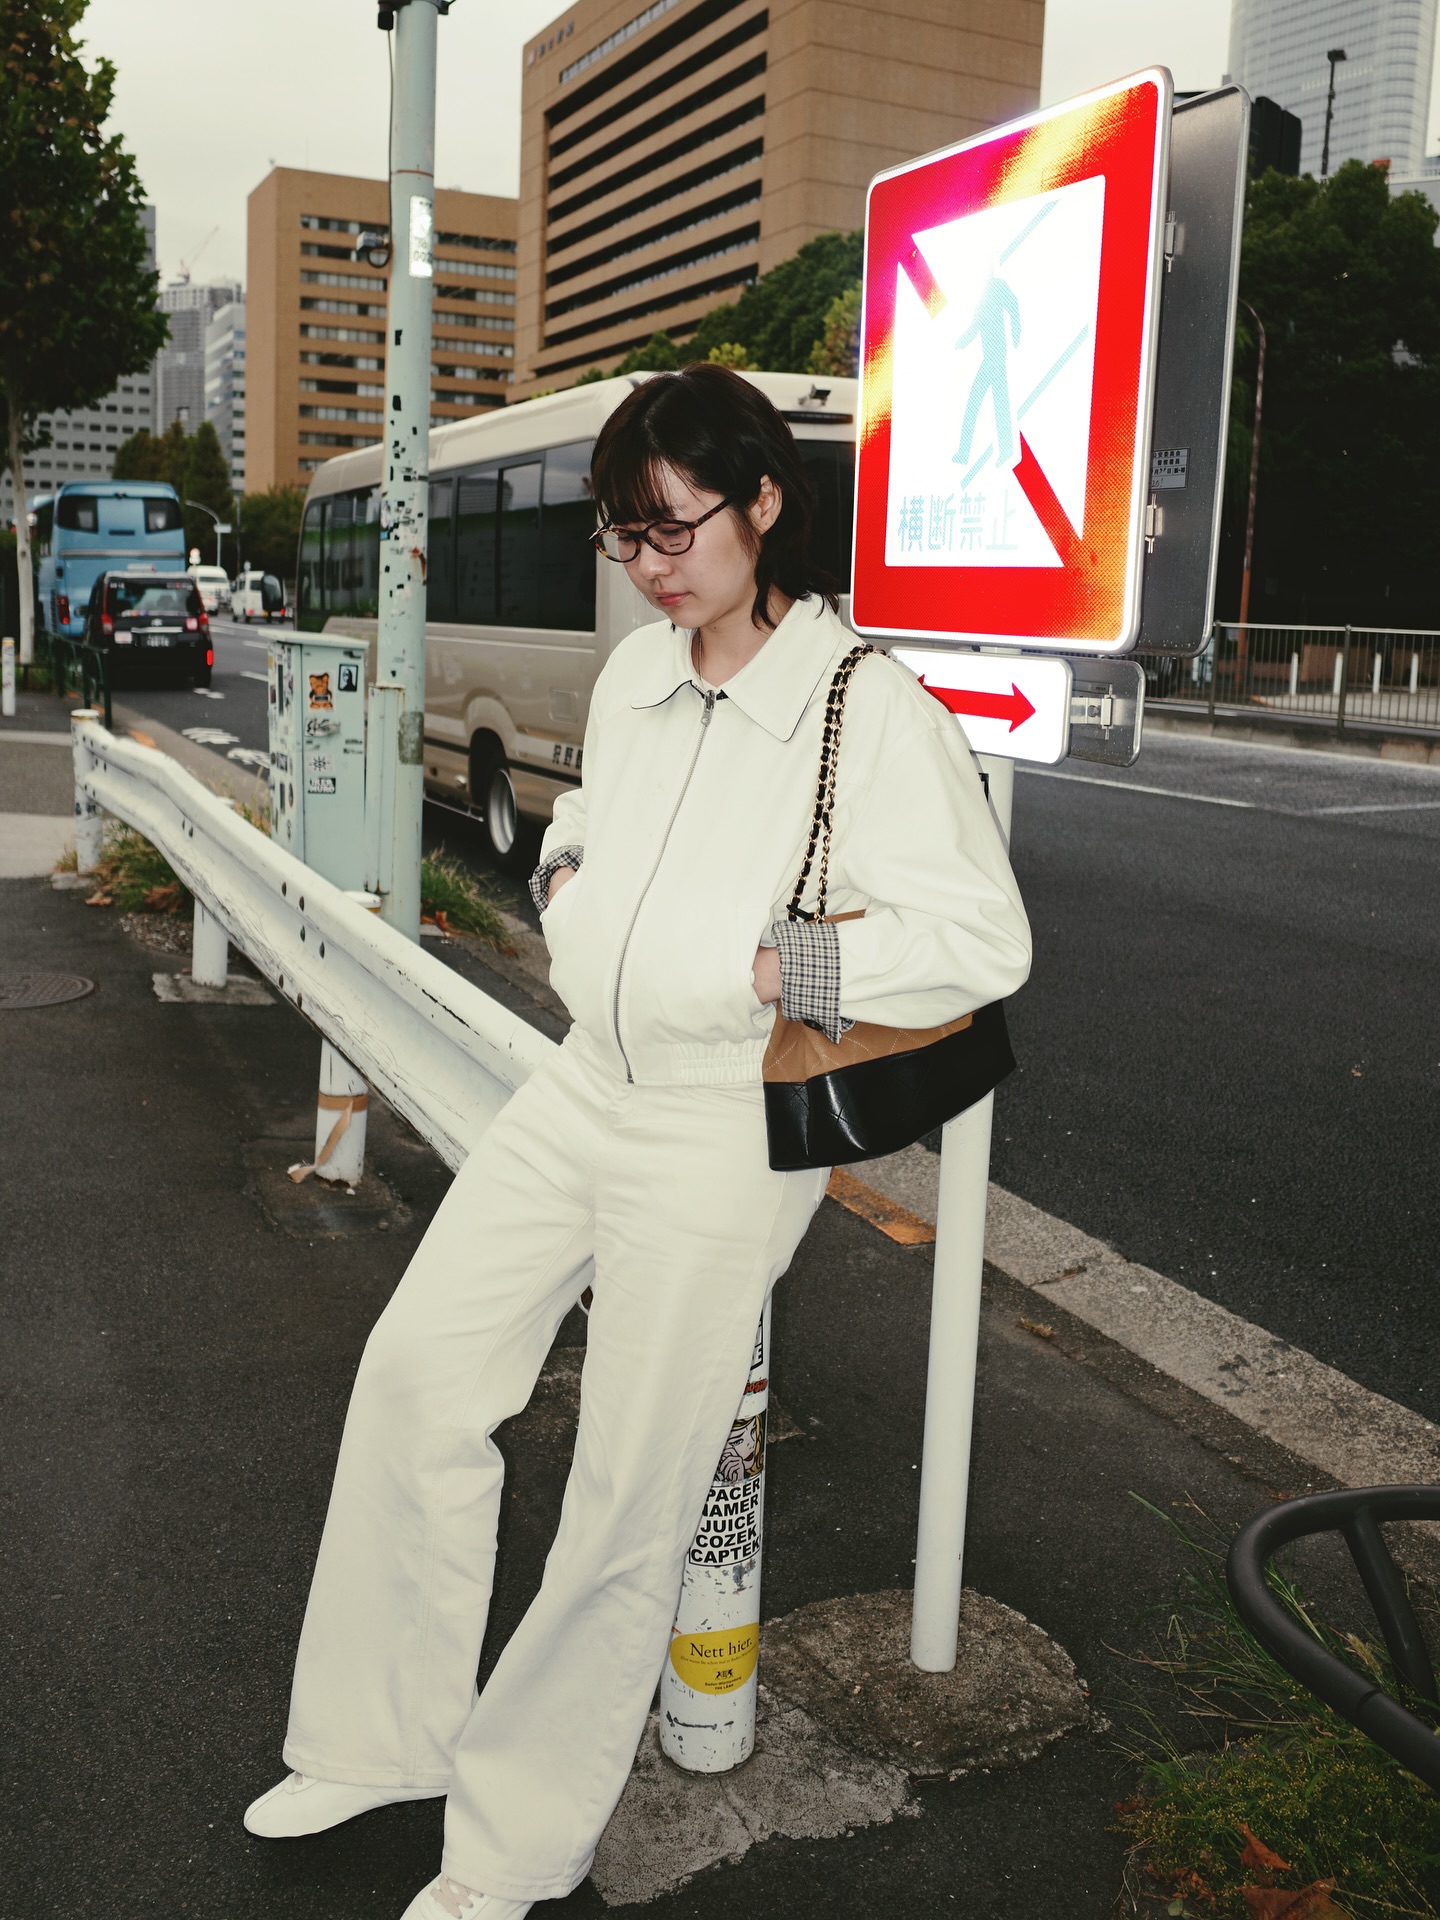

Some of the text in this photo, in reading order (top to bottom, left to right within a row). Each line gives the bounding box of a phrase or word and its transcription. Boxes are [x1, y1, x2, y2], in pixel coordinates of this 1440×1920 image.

[898, 489, 1019, 552] 横断禁止
[700, 1511, 755, 1533] JUICE
[696, 1524, 757, 1549] COZEK
[691, 1536, 760, 1563] CAPTEK
[690, 1638, 752, 1658] Nett hier.
